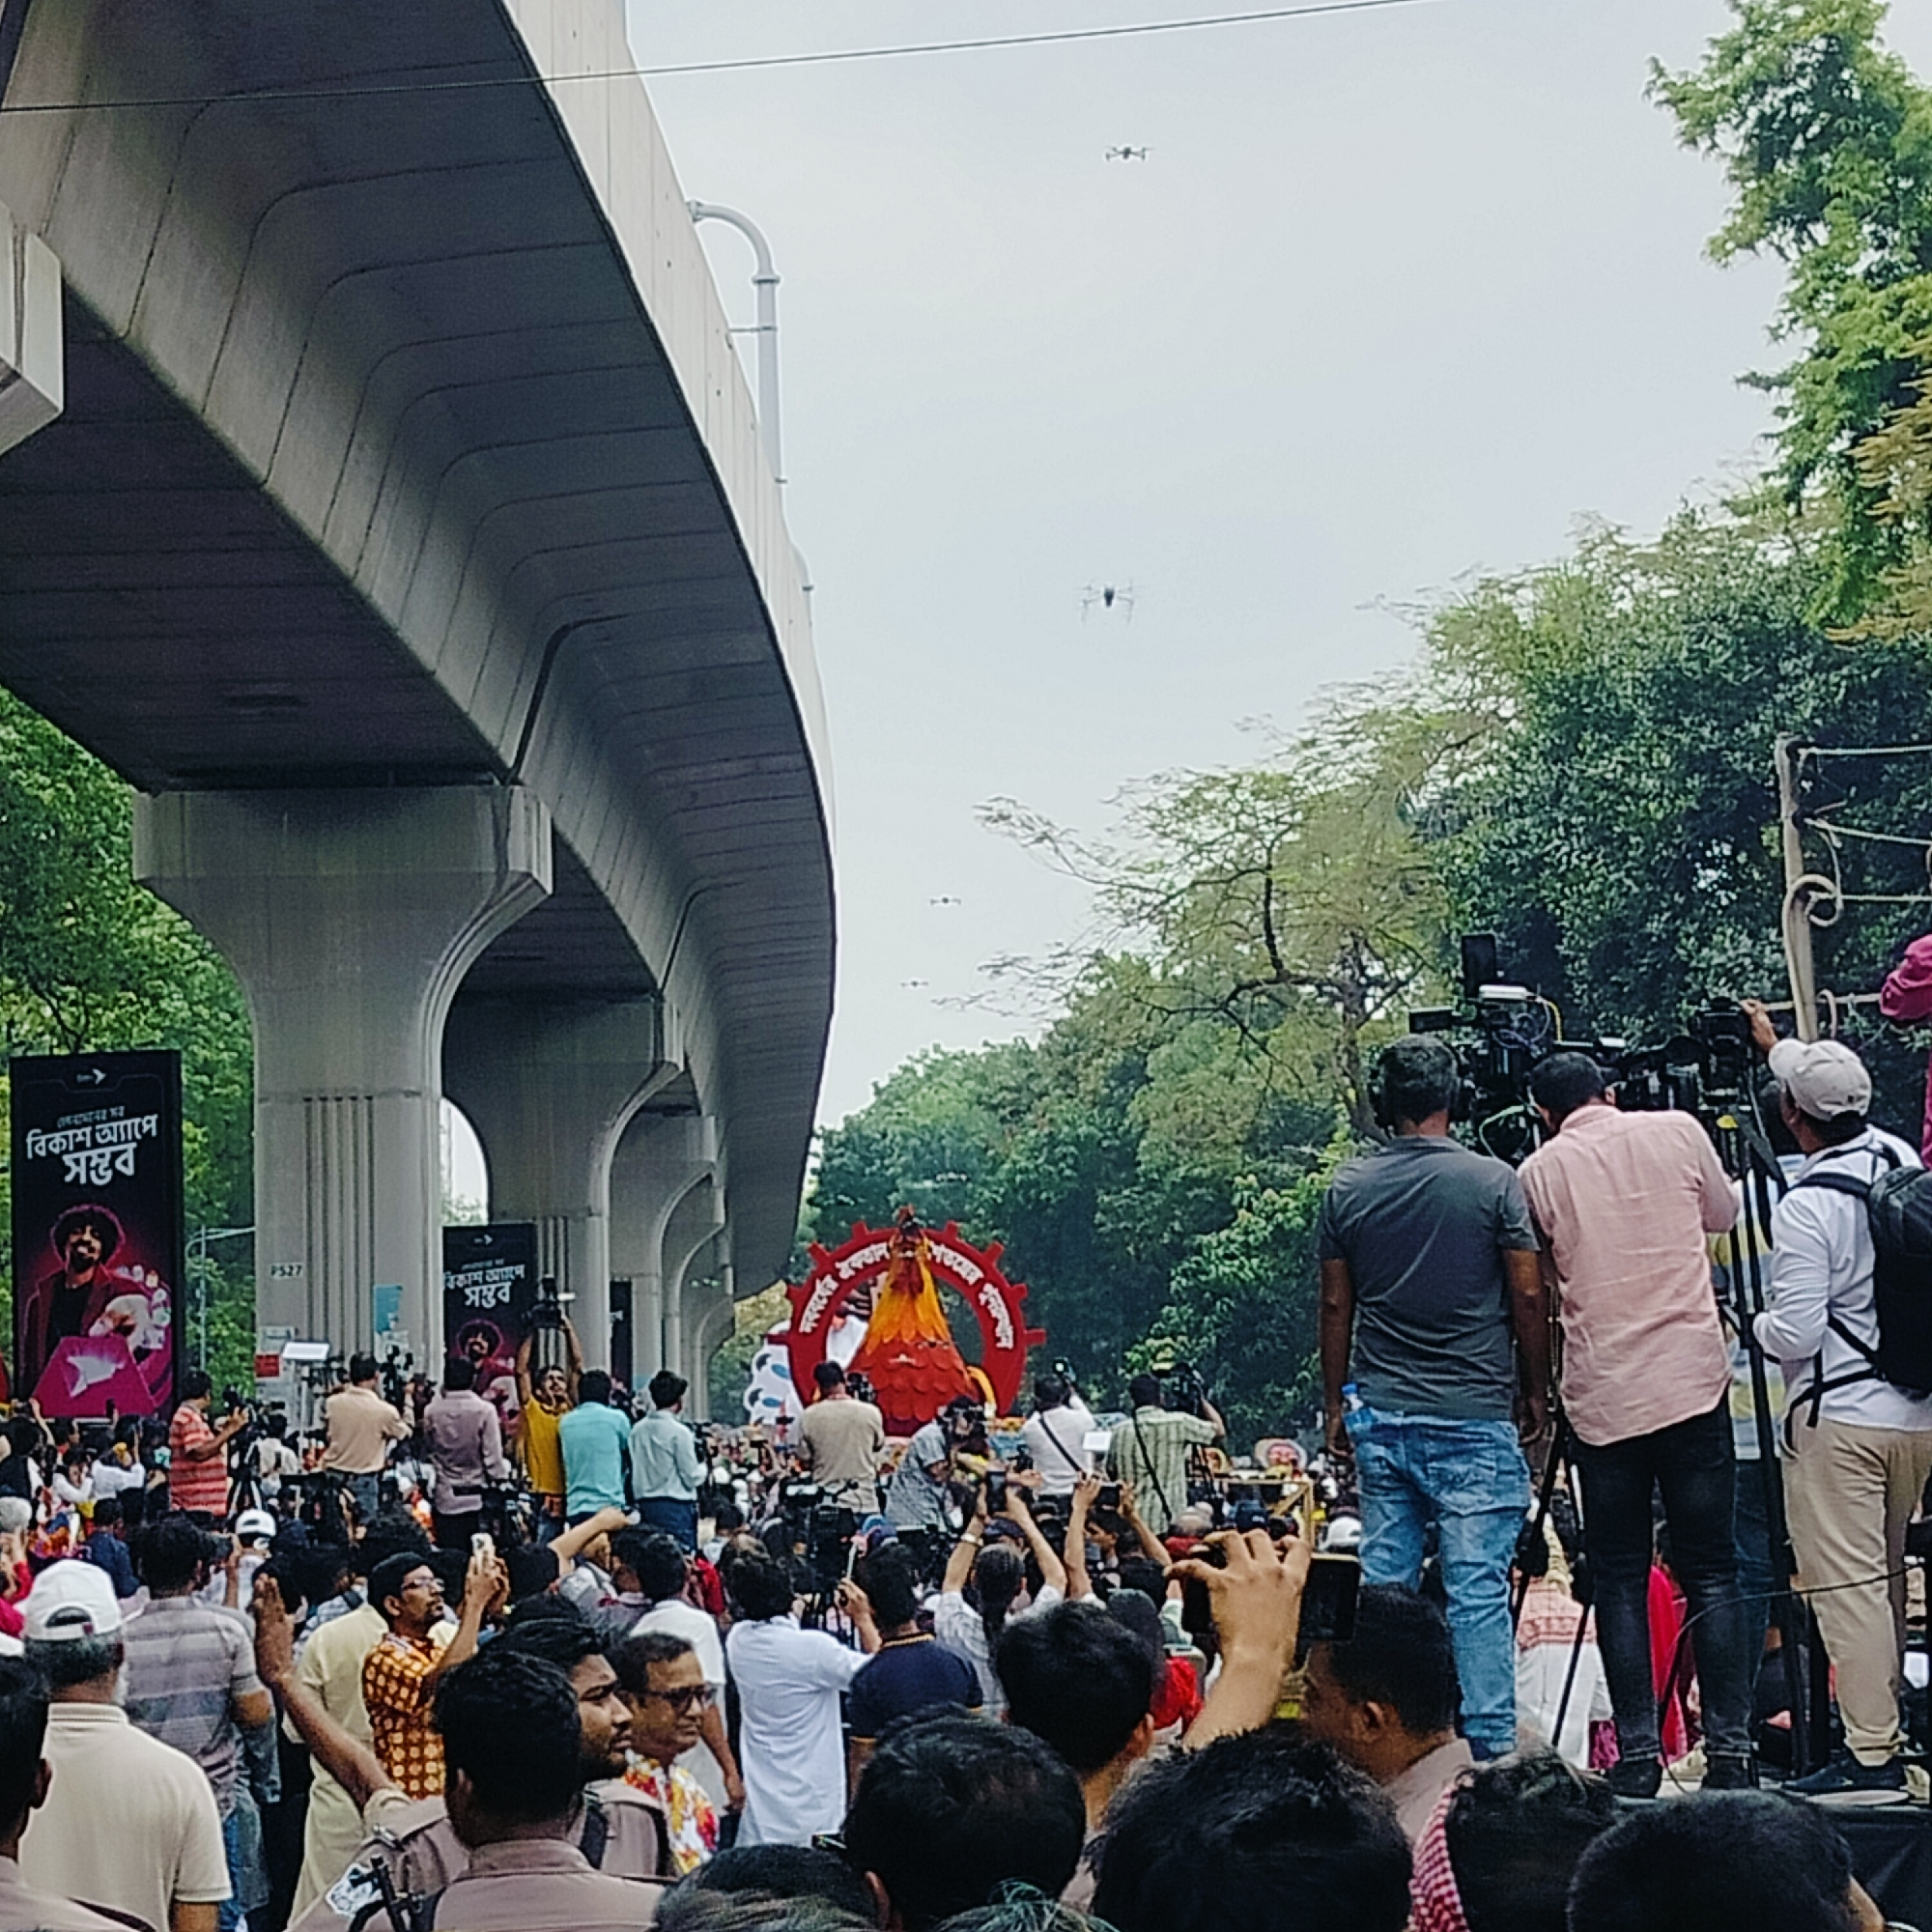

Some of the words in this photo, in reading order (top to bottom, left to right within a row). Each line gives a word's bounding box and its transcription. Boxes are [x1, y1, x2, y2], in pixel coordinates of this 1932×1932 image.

[26, 1125, 93, 1160] বিকাশ
[95, 1114, 158, 1144] অ্যাপে
[62, 1142, 137, 1186] সম্ভব
[464, 1281, 512, 1309] সম্ভব
